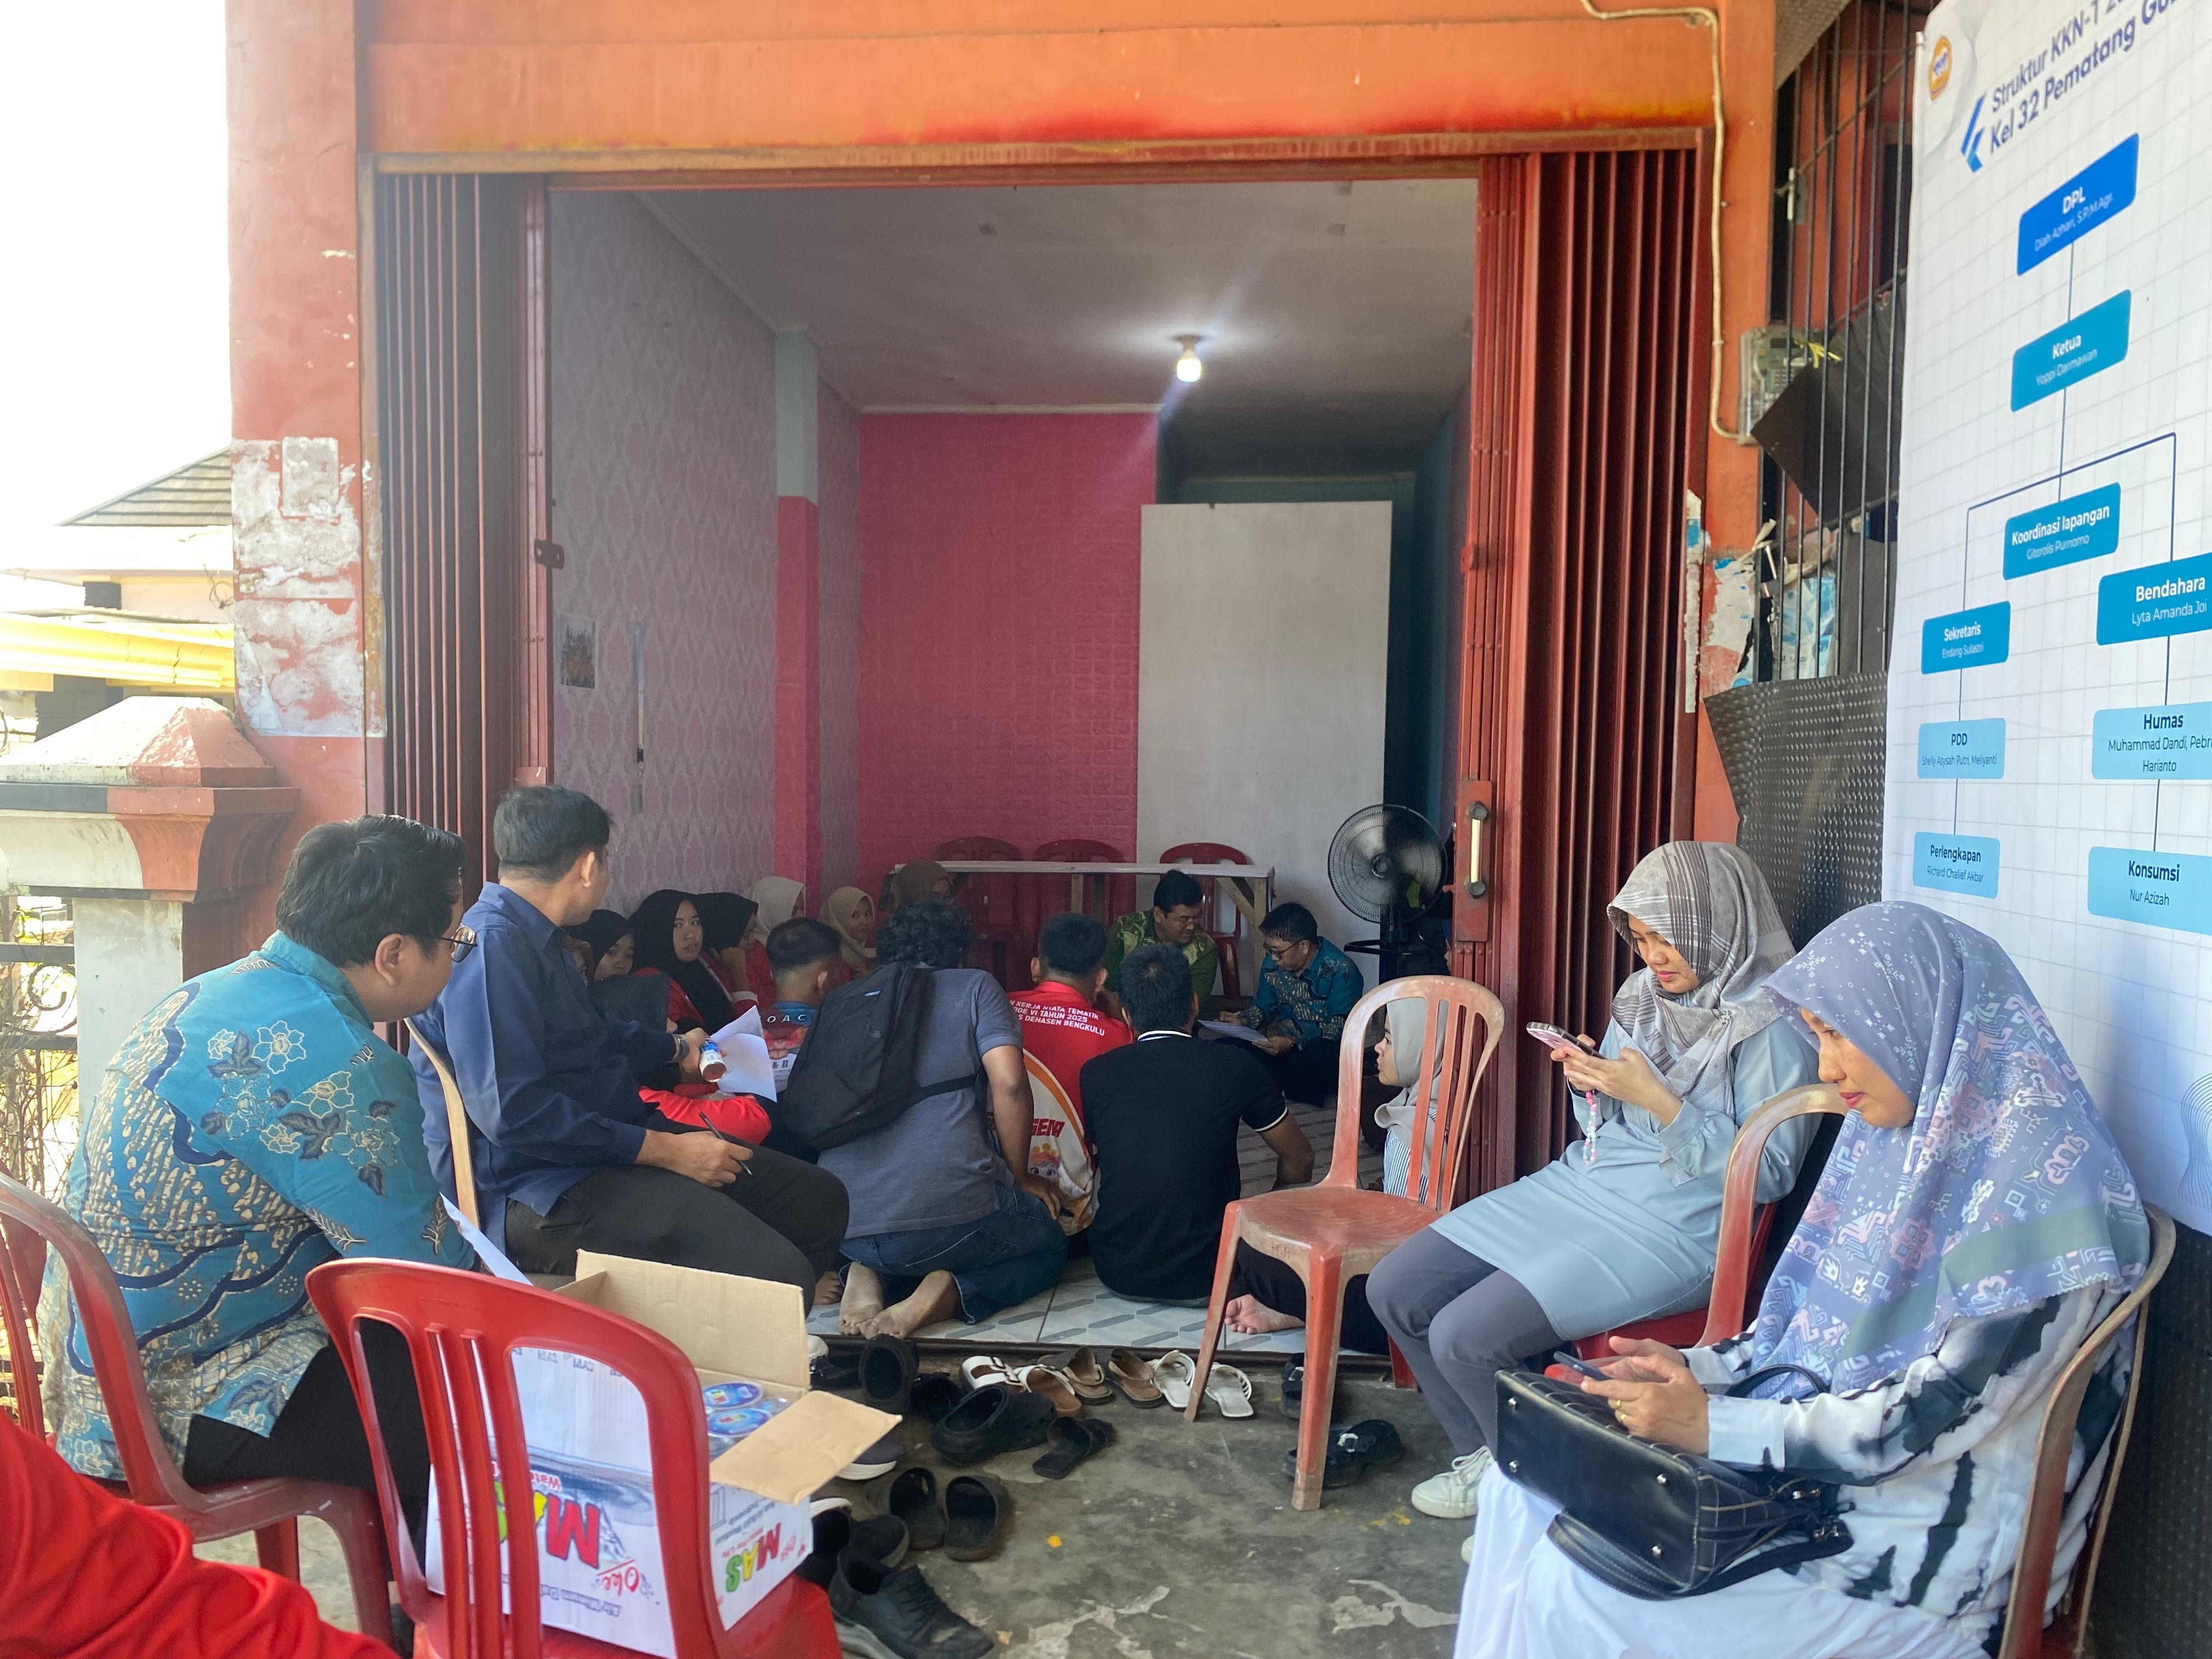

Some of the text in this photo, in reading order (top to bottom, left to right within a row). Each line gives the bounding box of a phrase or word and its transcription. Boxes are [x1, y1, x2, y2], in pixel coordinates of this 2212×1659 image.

[1990, 0, 2178, 154] Kel 32 Pematang Gu
[1992, 49, 2047, 112] Struktur
[2062, 187, 2086, 215] DPL
[2052, 335, 2081, 360] Ketua
[2012, 506, 2109, 546] Koordinasi lapangan
[2136, 577, 2205, 602] Bendahara
[2132, 598, 2208, 627] Lyta Amanda Joi
[1944, 621, 1981, 641] Sekretaris
[1942, 647, 1962, 658] Endang
[2143, 714, 2183, 730] Humas
[1951, 733, 1967, 746] PDD
[2108, 737, 2160, 751] Muhammad
[2163, 736, 2187, 751] Dandi,
[1922, 755, 1937, 768] Shelly
[1972, 754, 1997, 767] Meliyanti
[2143, 759, 2177, 772] Harianto
[1931, 844, 1981, 864] Perlengkapan
[1927, 865, 1945, 877] Richard
[1967, 871, 1983, 882] Akbar
[2129, 860, 2180, 882] Konsumsi
[2130, 889, 2169, 906] Nur Azizah
[766, 1014, 807, 1023] OAC
[1016, 1001, 1041, 1010] KERJA
[1068, 1008, 1099, 1020] TEMATIK
[1040, 1011, 1065, 1019] TAHUN
[1066, 1014, 1088, 1023] 2025
[1025, 1015, 1062, 1025] DEHASEN
[1063, 1020, 1105, 1036] BENGKULU
[725, 1522, 781, 1593] MAS
[600, 1566, 640, 1595] Oke
